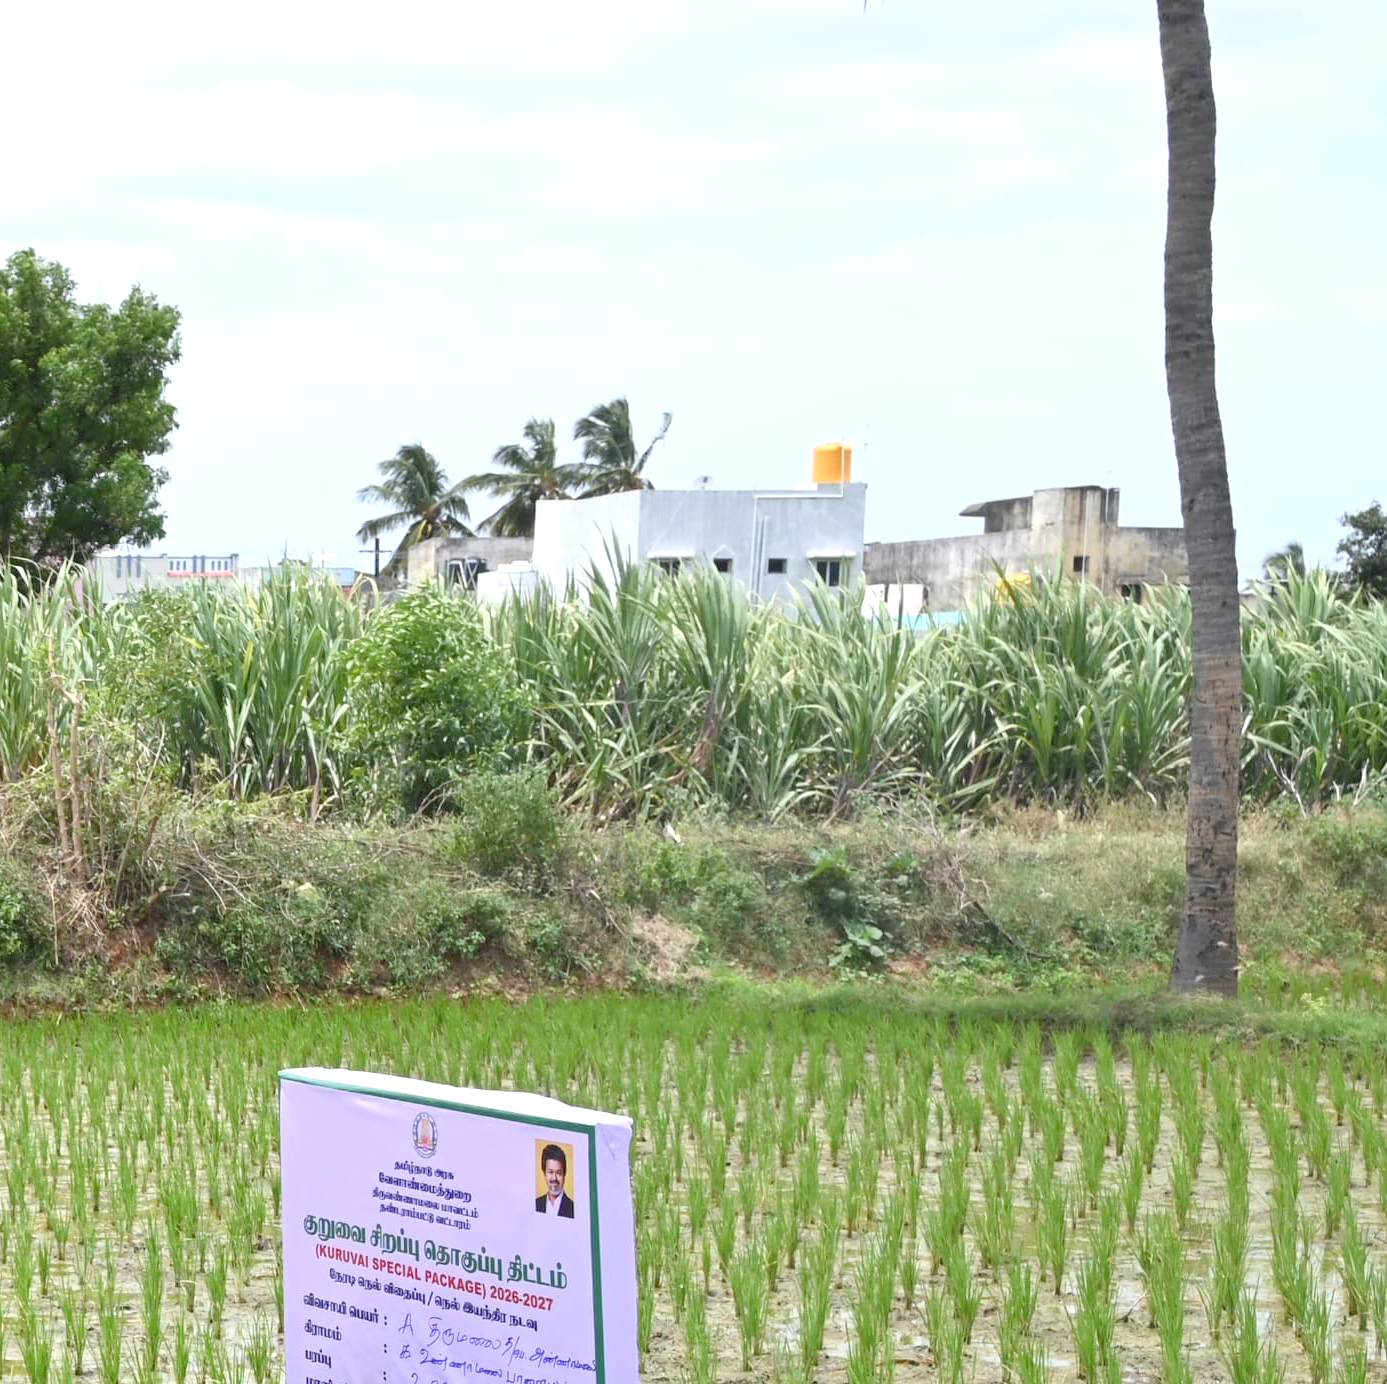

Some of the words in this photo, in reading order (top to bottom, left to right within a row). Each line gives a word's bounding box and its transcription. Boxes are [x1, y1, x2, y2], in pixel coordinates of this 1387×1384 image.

[394, 1160, 433, 1177] தமிழ்நாடு
[434, 1168, 455, 1180] அரசு
[378, 1171, 472, 1203] வேளாண்மைத்துறை
[372, 1187, 440, 1210] திருவண்ணாமலை
[441, 1203, 479, 1219] மாவட்டம்
[379, 1202, 435, 1223] தண்டராம்பட்டு
[435, 1215, 471, 1230] வட்டாரம்
[303, 1214, 366, 1244] குறுவை
[370, 1223, 420, 1262] சிறப்பு
[424, 1239, 503, 1281] தொகுப்பு
[507, 1254, 568, 1289] திட்டம்
[315, 1243, 369, 1268] (KURUVAI
[372, 1257, 422, 1281] SPECIAL
[425, 1270, 487, 1300] PACKAGE)
[489, 1285, 554, 1312] 2026-2027
[303, 1292, 347, 1315] விவசாயி
[349, 1305, 379, 1323] பெயர்
[329, 1267, 356, 1287] நேரடி
[357, 1277, 382, 1292] நெல்
[383, 1282, 426, 1305] விதைப்பு
[434, 1296, 460, 1311] நெல்
[463, 1301, 507, 1323] இயந்திர
[509, 1315, 538, 1332] நடவு
[304, 1318, 342, 1341] கிராமம்
[305, 1348, 332, 1369] பரப்பு
